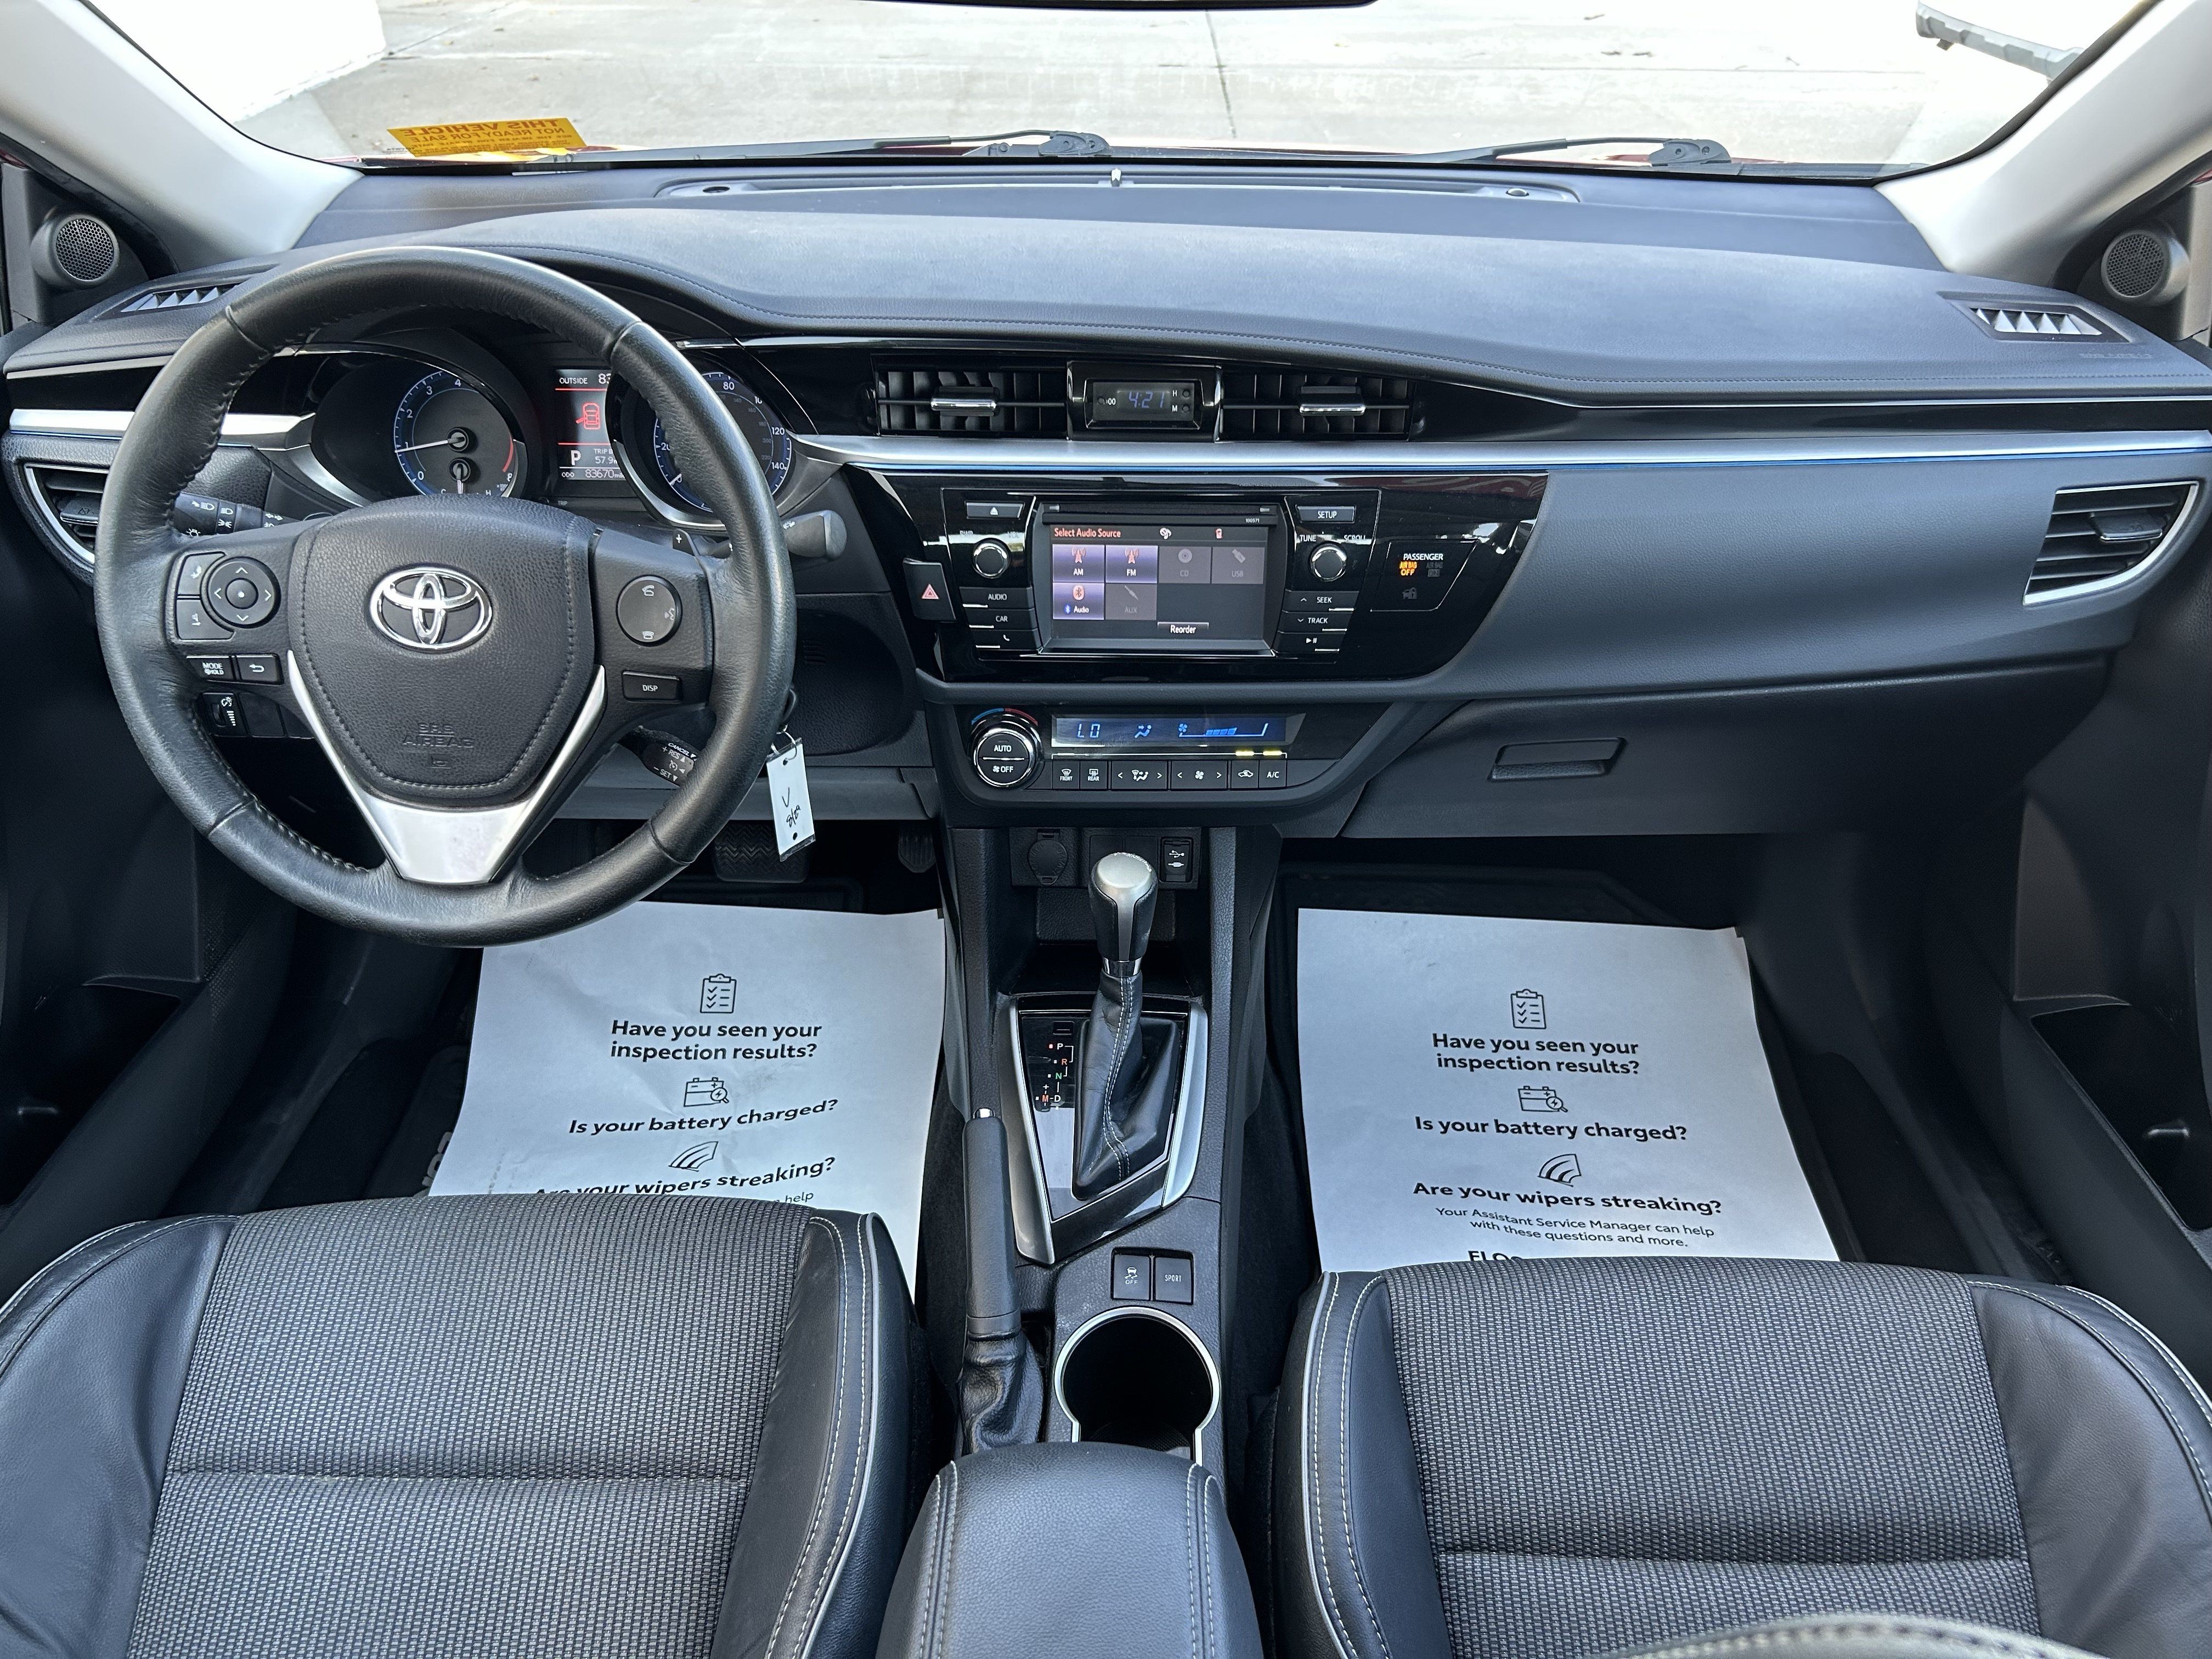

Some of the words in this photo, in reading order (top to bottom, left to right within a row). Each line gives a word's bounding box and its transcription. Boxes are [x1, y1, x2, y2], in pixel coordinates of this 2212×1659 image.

[455, 379, 461, 387] 4
[723, 381, 735, 391] 80
[426, 386, 433, 395] 3
[1128, 391, 1165, 408] 4:21
[406, 409, 413, 418] 2
[771, 427, 785, 436] 120
[571, 450, 581, 466] P
[772, 462, 785, 470] 140
[417, 471, 425, 481] 0
[1318, 511, 1337, 519] SETUP
[1054, 527, 1075, 537] Select
[1076, 528, 1097, 538] Audio
[1098, 528, 1121, 538] Source
[1073, 568, 1084, 576] AM
[1126, 568, 1136, 577] FM
[1170, 624, 1197, 634] Reorder
[402, 735, 475, 748] AIRBAG
[668, 742, 690, 757] CANCEL
[668, 749, 681, 760] RES
[659, 768, 672, 778] SET
[1267, 771, 1279, 780] A/C
[611, 1020, 667, 1037] Have
[671, 1025, 712, 1041] you
[717, 1025, 767, 1037] seen
[772, 1025, 822, 1041] your
[1432, 1032, 1485, 1049] Have
[1491, 1038, 1530, 1053] you
[1535, 1039, 1585, 1053] seen
[1589, 1041, 1639, 1056] your
[611, 1041, 726, 1062] inspection
[732, 1043, 817, 1060] results?
[1436, 1053, 1551, 1072] inspection
[1556, 1058, 1639, 1074] results?
[569, 1120, 587, 1134] Is
[591, 1120, 645, 1136] your
[648, 1114, 732, 1131] battery
[737, 1099, 839, 1125] charged?
[1415, 1116, 1434, 1131] Is
[1437, 1119, 1489, 1135] your
[1493, 1119, 1578, 1139] battery
[1584, 1122, 1687, 1142] charged?
[635, 1177, 712, 1195] wipers
[716, 1156, 836, 1187] streaking?
[785, 1192, 814, 1203] help
[1413, 1182, 1454, 1196] Are
[1458, 1186, 1511, 1202] your
[1515, 1191, 1595, 1207] wipers
[1601, 1195, 1722, 1216] streaking?
[1436, 1207, 1468, 1217] Your
[1472, 1209, 1533, 1226] Assistant
[1536, 1217, 1586, 1229] Service
[1589, 1220, 1651, 1234] Manager
[1655, 1224, 1680, 1233] can
[1683, 1224, 1715, 1238] help
[1470, 1220, 1500, 1232] with
[1503, 1225, 1542, 1239] these
[1544, 1231, 1613, 1244] questions
[1617, 1234, 1644, 1245] and
[1647, 1238, 1689, 1248] more.
[1164, 1274, 1182, 1283] SPORT
